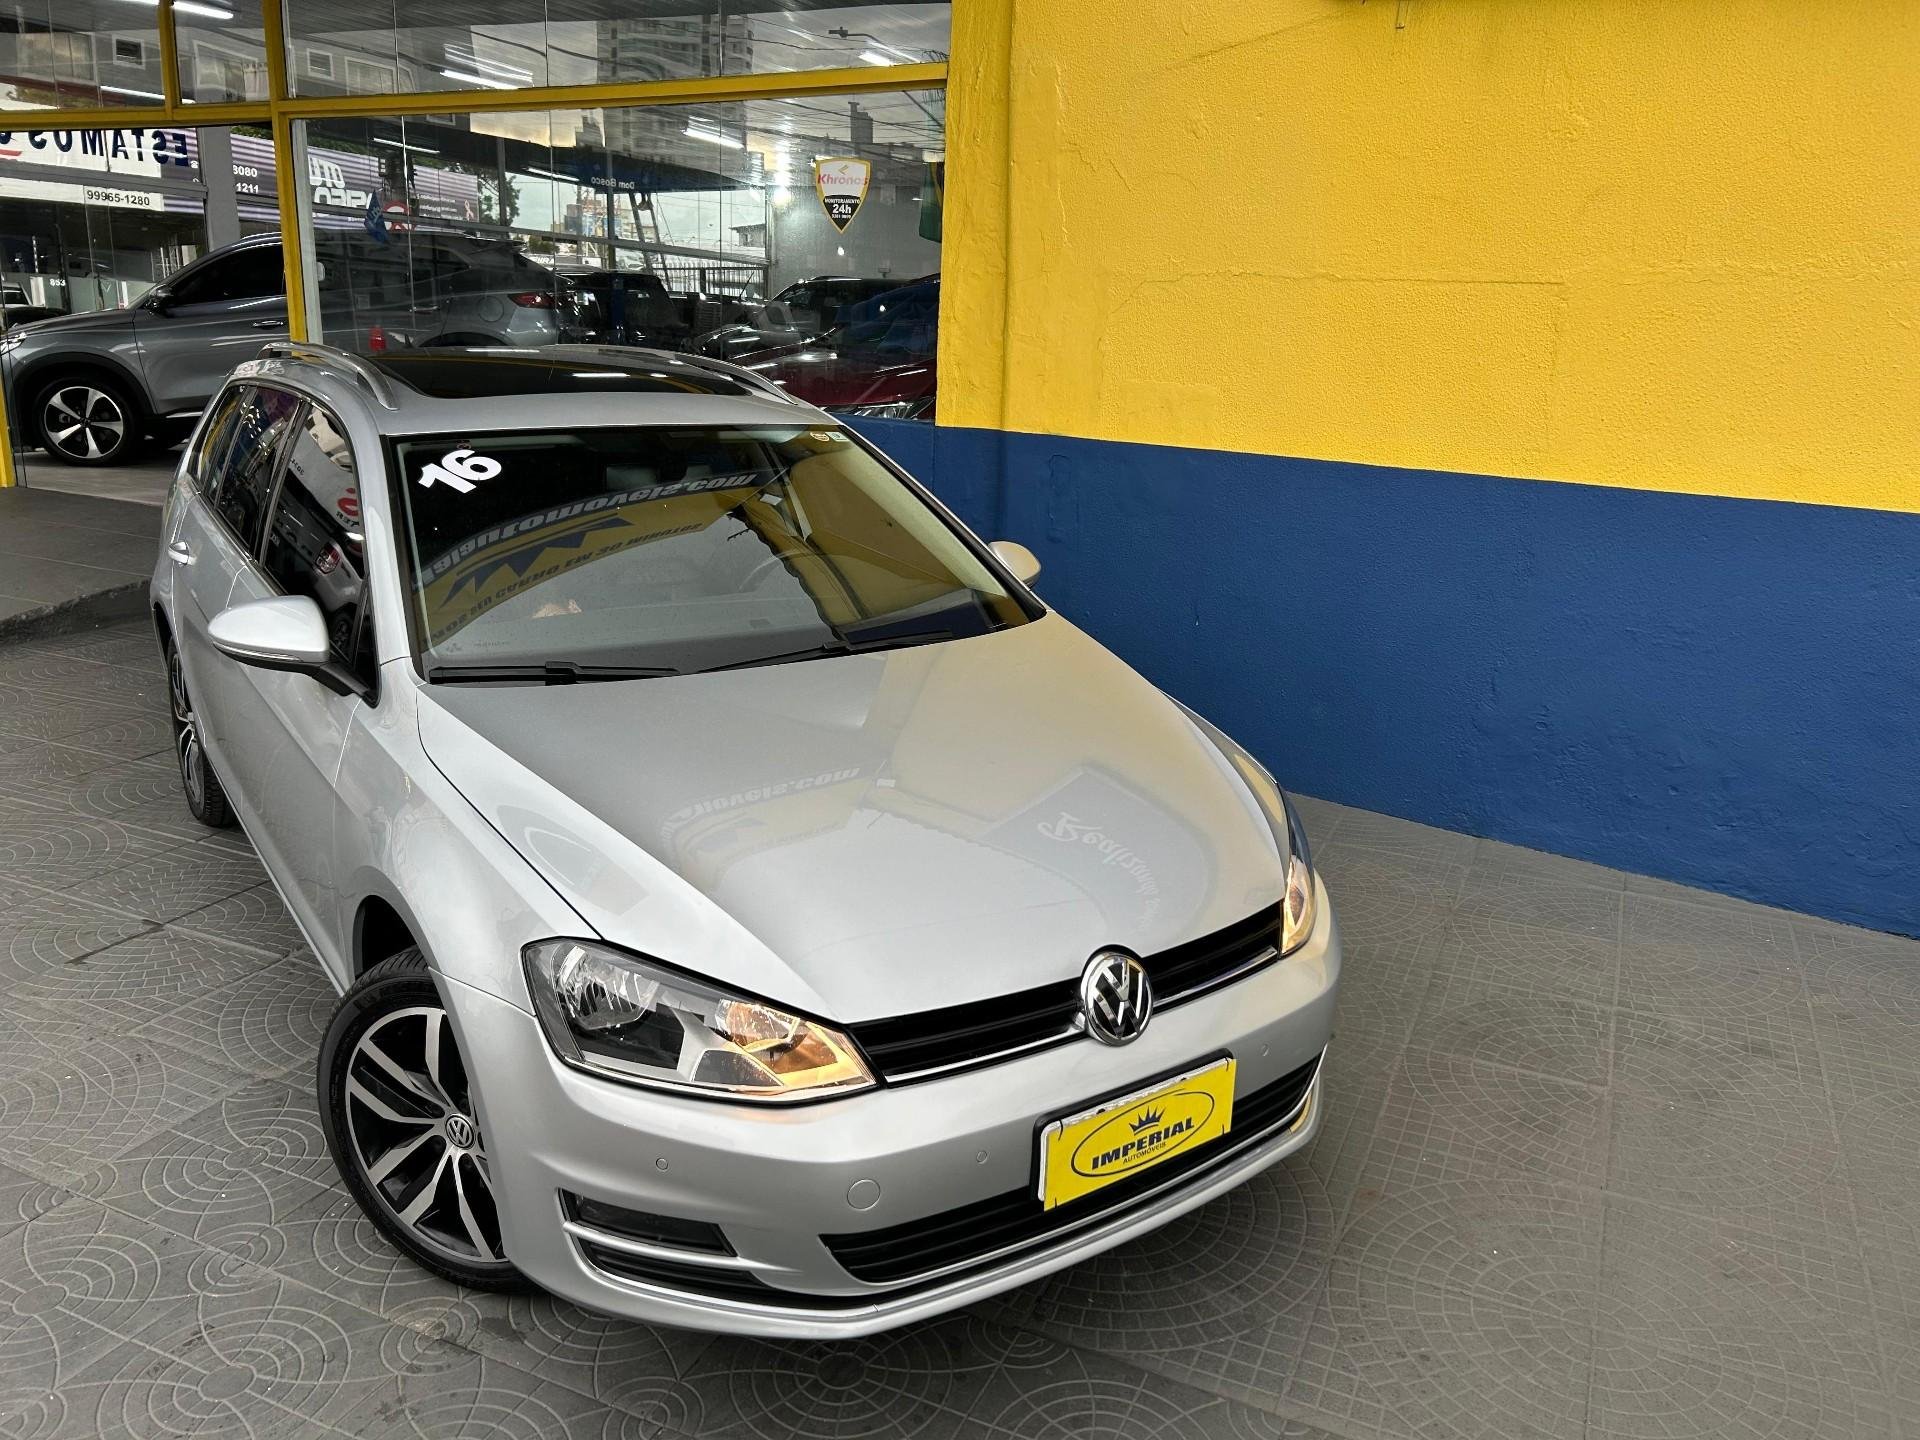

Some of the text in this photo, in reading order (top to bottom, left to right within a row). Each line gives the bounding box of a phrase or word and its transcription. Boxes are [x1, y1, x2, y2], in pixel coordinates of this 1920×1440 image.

[817, 173, 869, 186] Khronos
[87, 189, 151, 206] 99965-1280
[832, 203, 852, 214] 24h
[418, 448, 502, 494] 16
[1091, 1116, 1195, 1171] IMPERIAL
